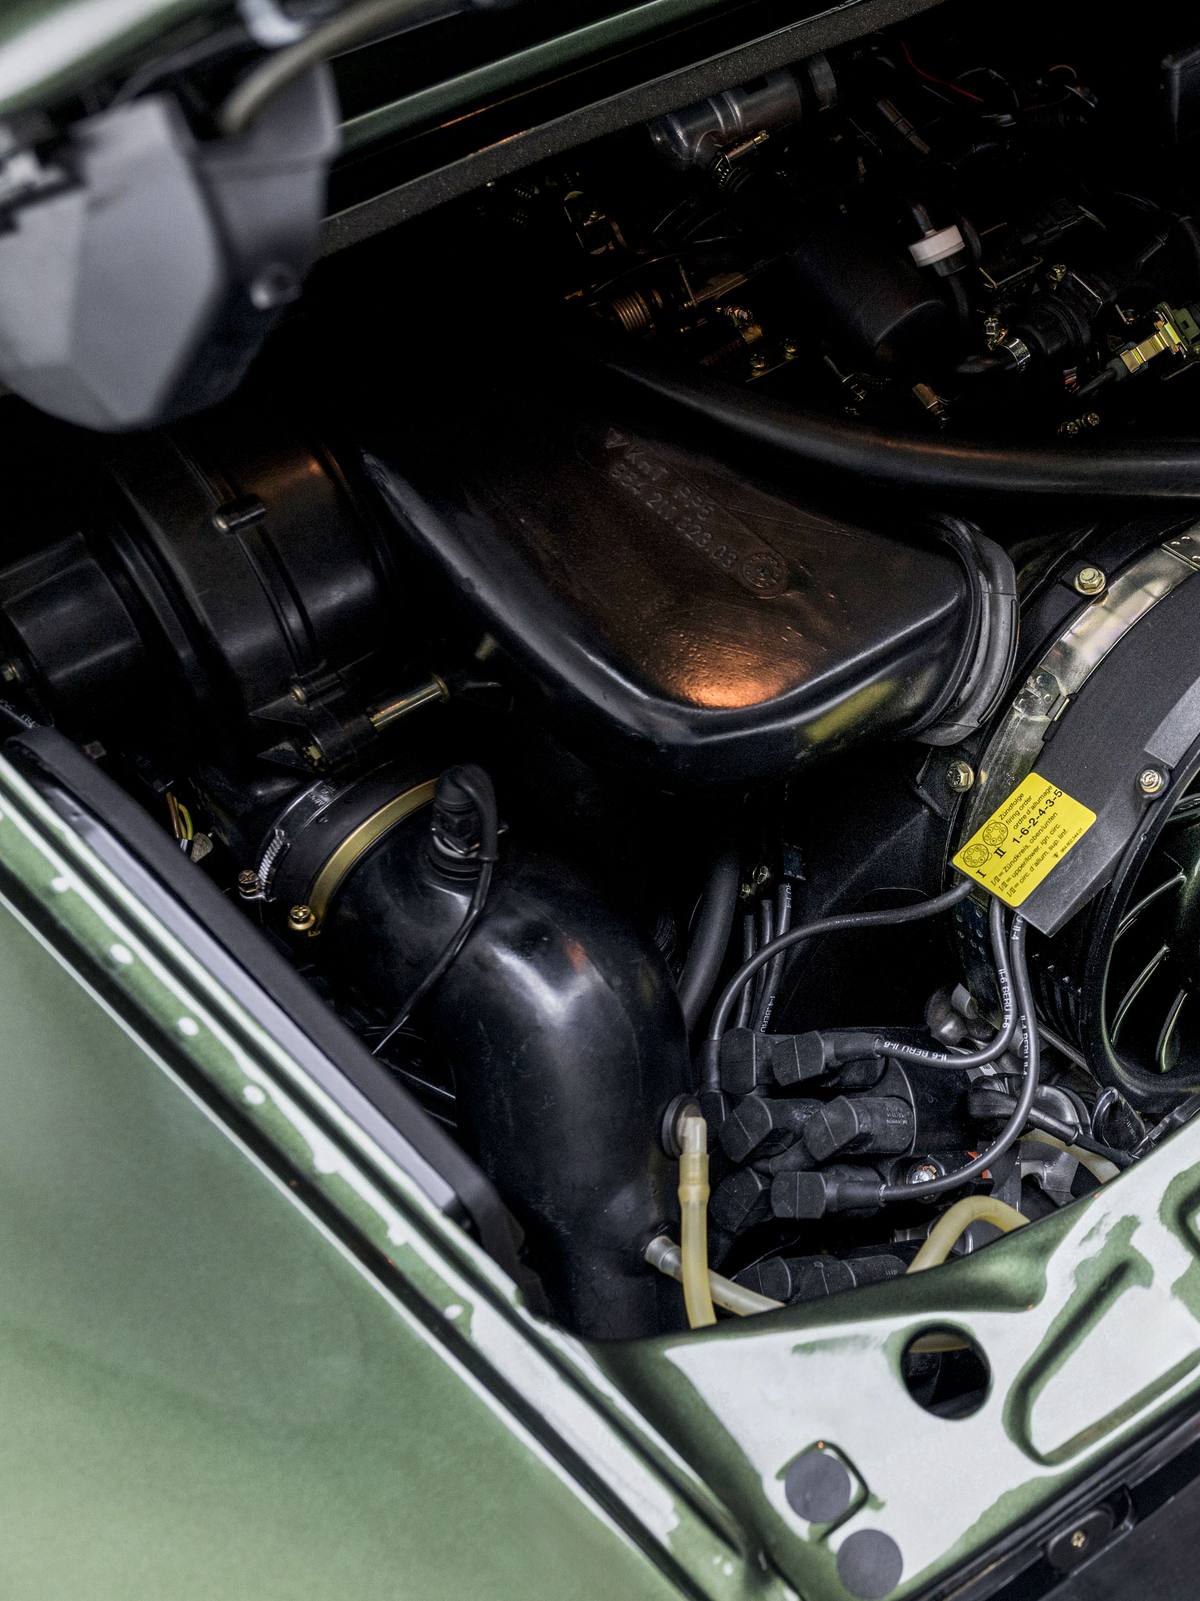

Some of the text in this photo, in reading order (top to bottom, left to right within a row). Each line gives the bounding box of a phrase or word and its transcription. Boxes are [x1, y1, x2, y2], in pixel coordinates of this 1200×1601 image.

[1005, 795, 1032, 824] firing order
[1012, 789, 1063, 844] 1-6-2-4-3-5
[1012, 813, 1027, 829] ordre
[1002, 986, 1013, 1012] BERU
[901, 1045, 930, 1058] BERU
[932, 1051, 948, 1062] II-6
